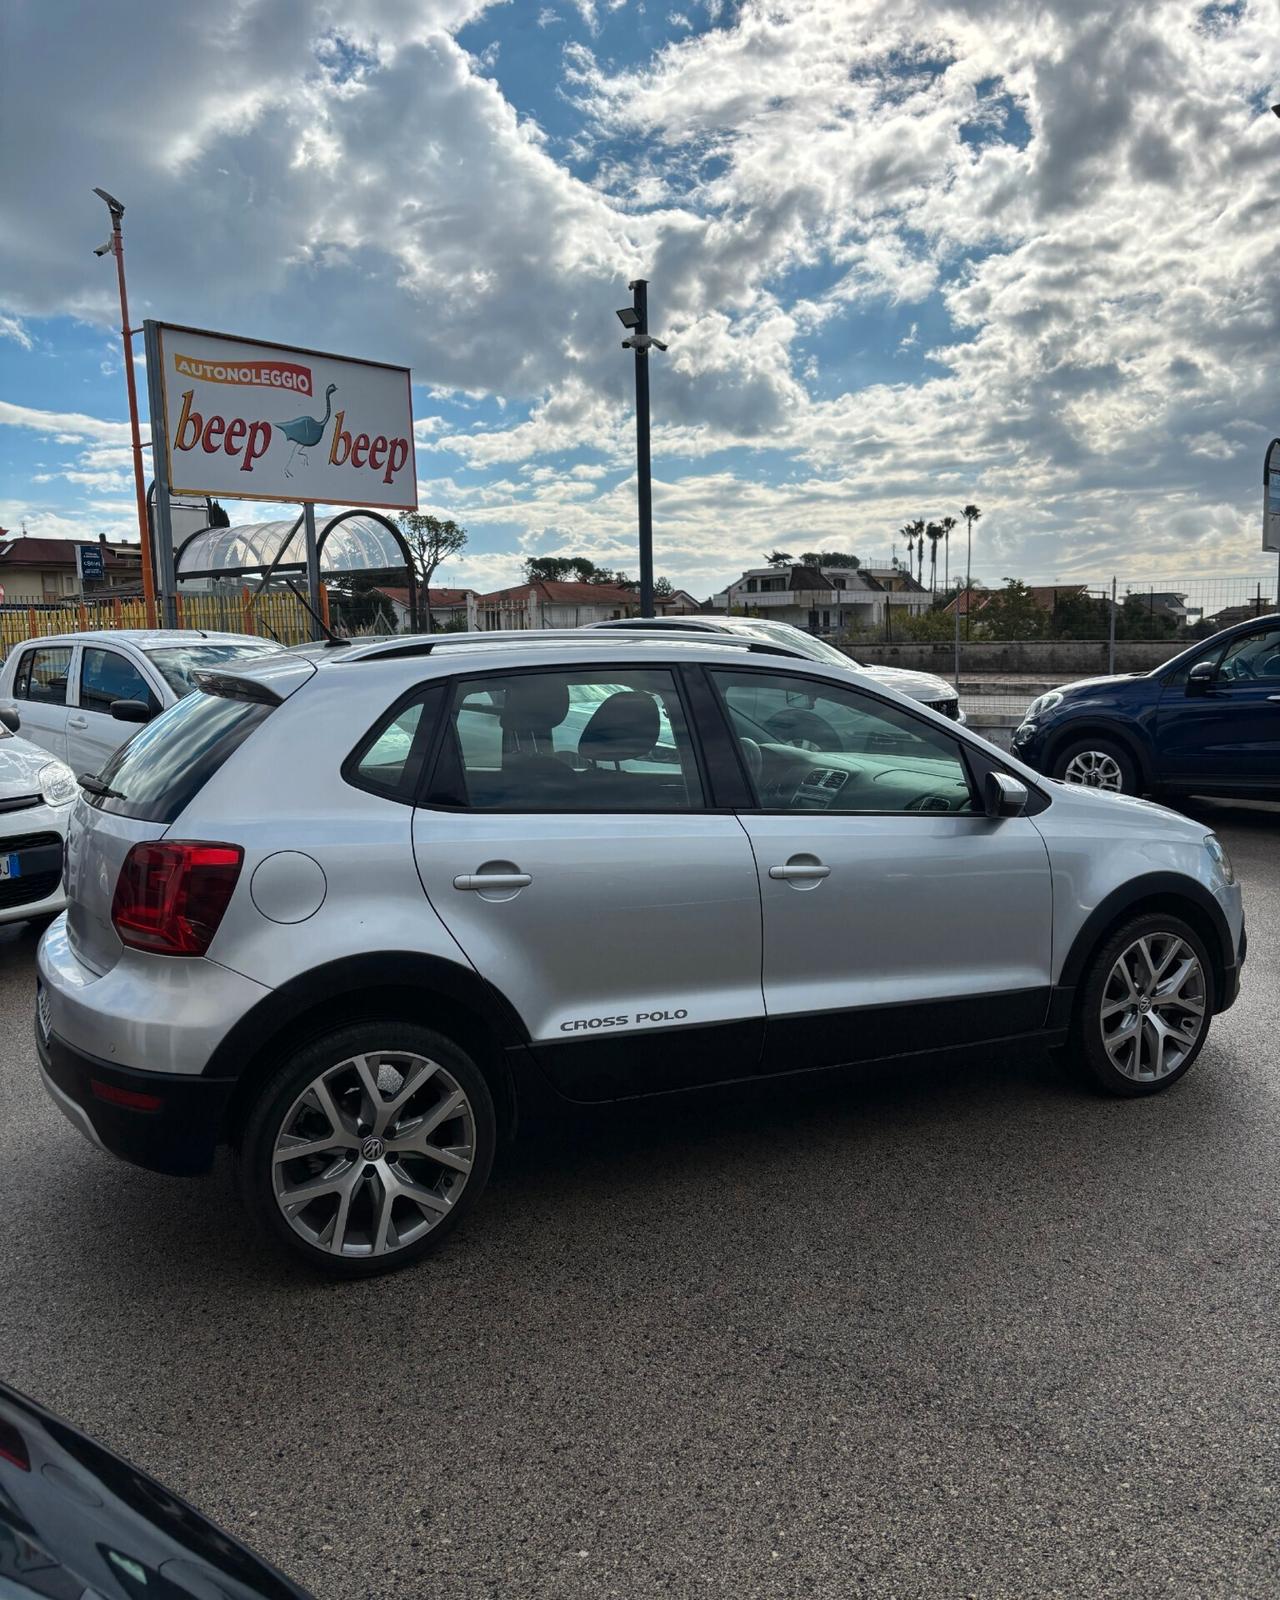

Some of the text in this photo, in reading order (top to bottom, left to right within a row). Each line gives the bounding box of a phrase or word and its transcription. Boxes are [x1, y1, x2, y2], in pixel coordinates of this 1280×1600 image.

[178, 361, 309, 391] AUTONOLEGGIO
[174, 390, 409, 483] beep beep
[560, 1009, 688, 1031] CROSS POLO
